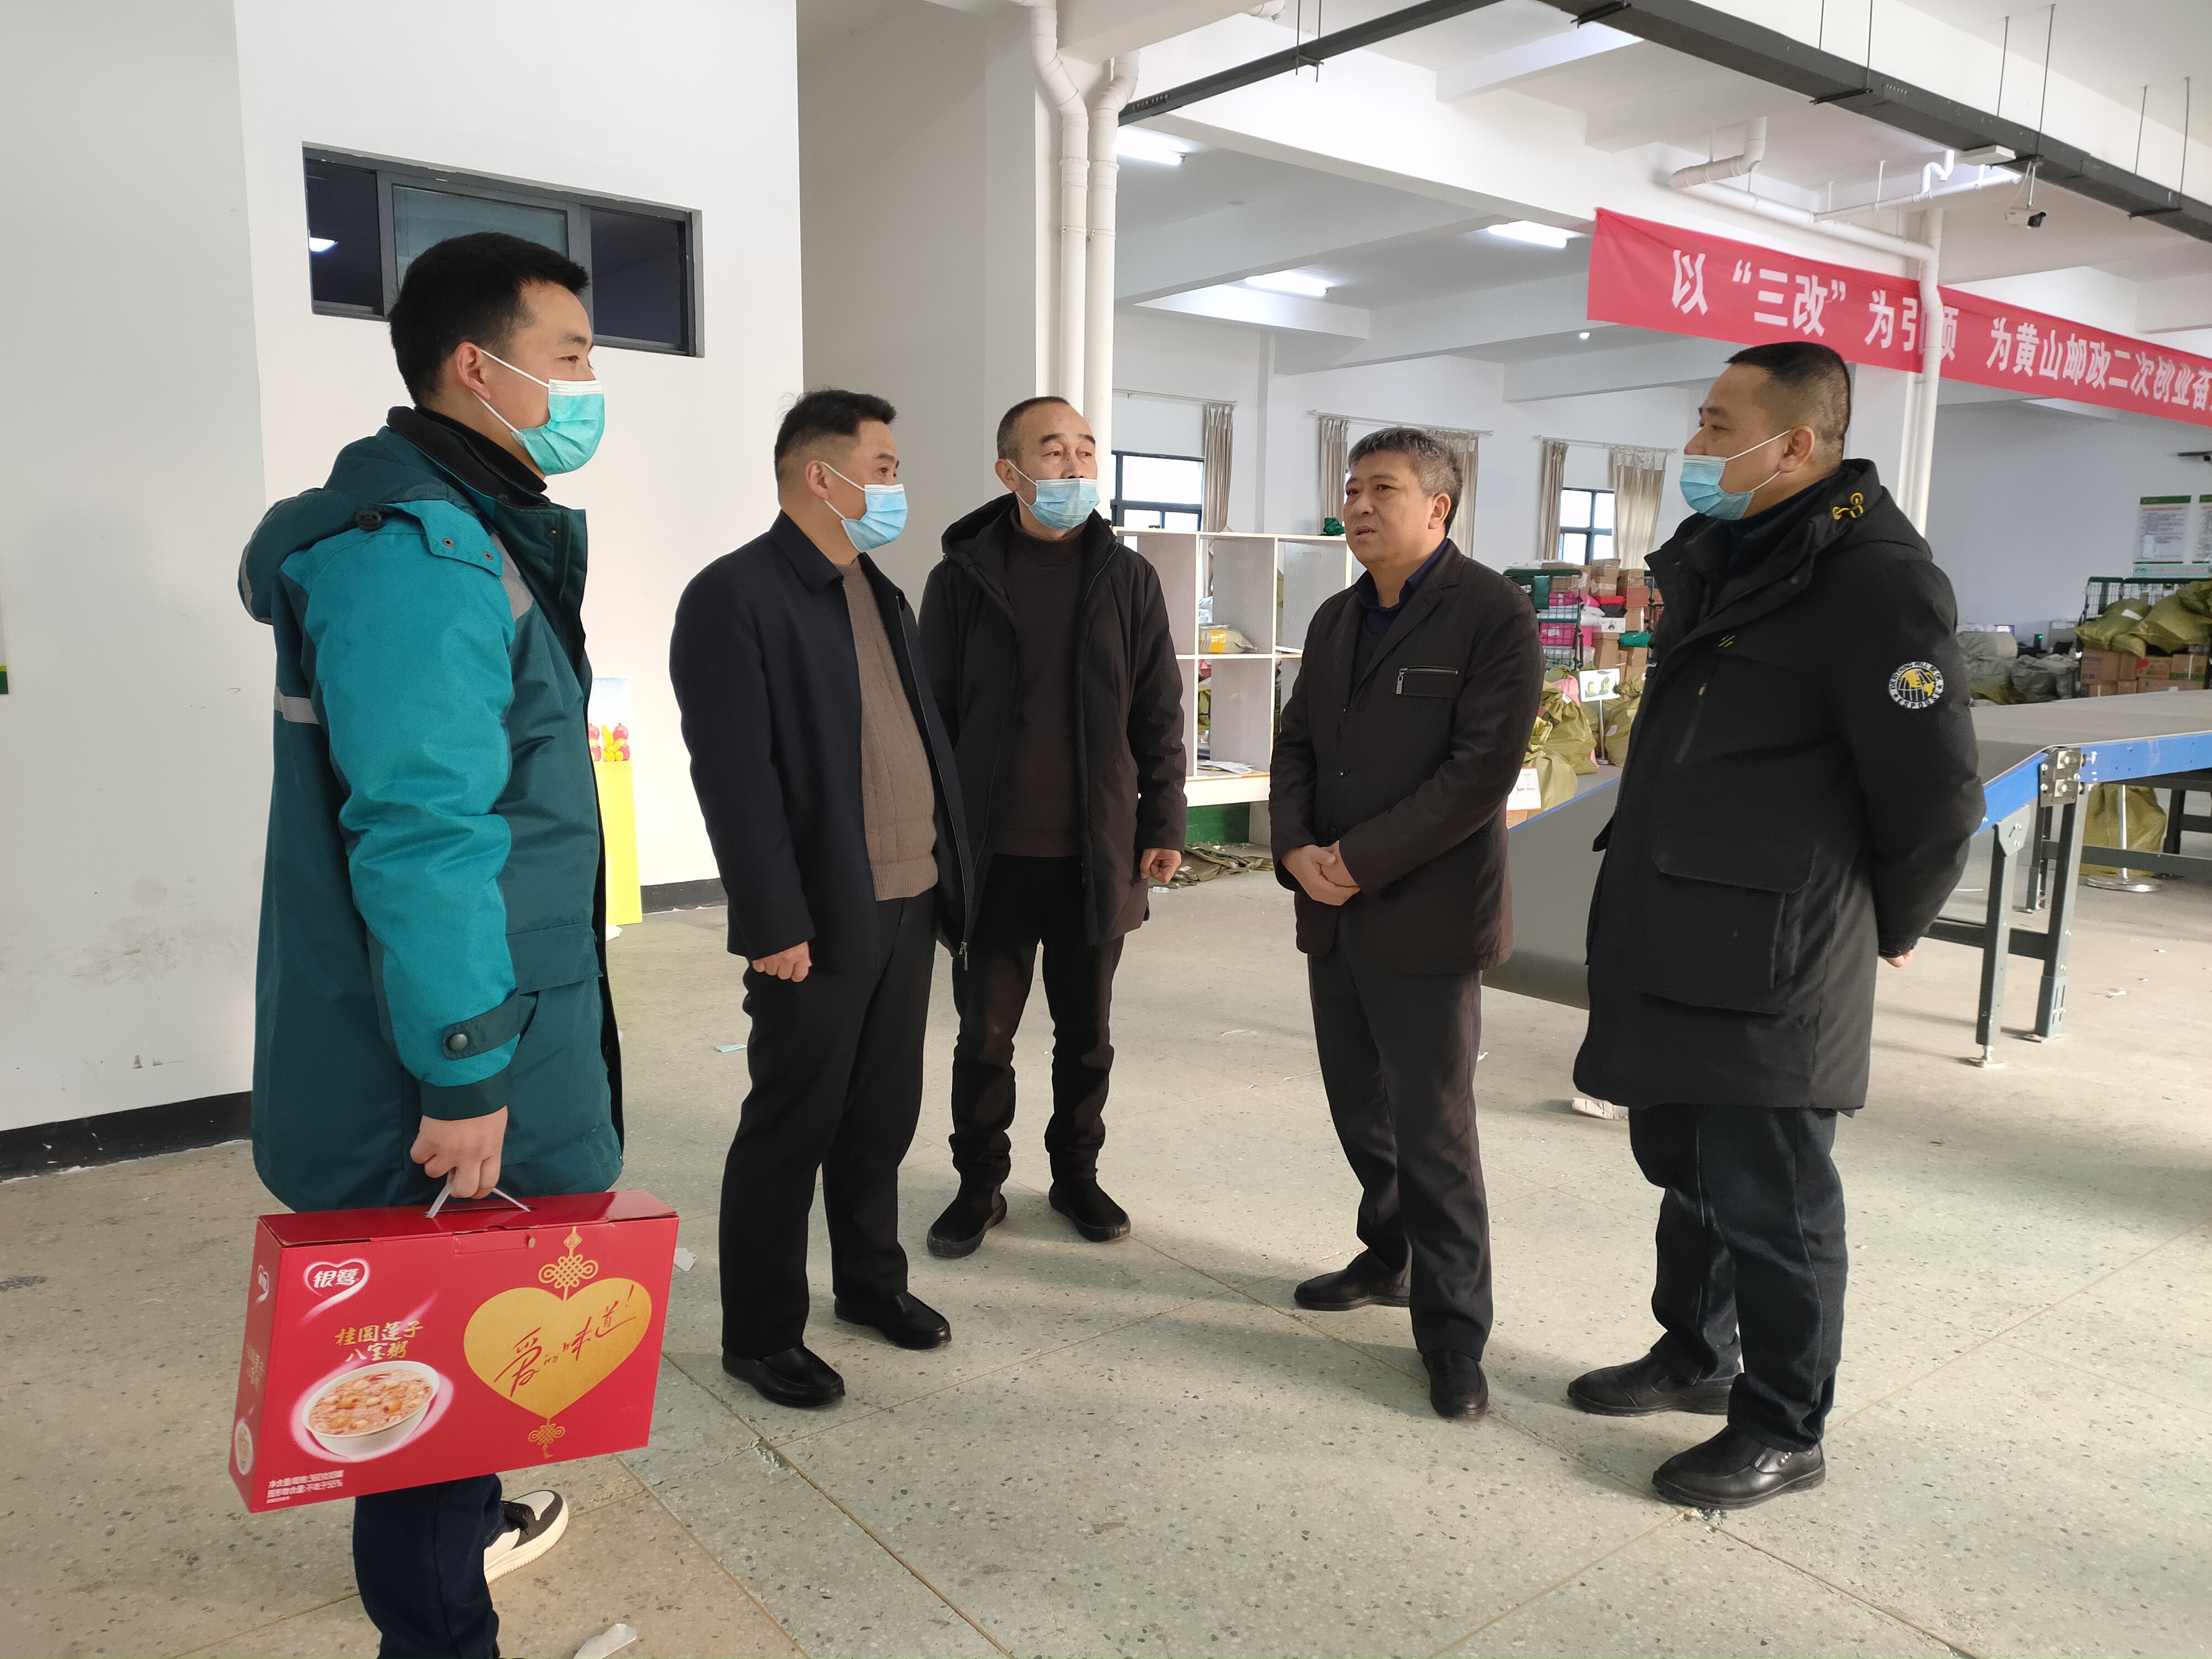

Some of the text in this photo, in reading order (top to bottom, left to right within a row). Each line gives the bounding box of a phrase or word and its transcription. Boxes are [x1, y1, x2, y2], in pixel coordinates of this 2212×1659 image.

[1986, 316, 2212, 412] 为黄山邮政二次创业奋
[312, 1268, 359, 1288] 银鹭
[335, 1321, 423, 1347] 桂圆莲子
[345, 1340, 409, 1362] 八宝粥
